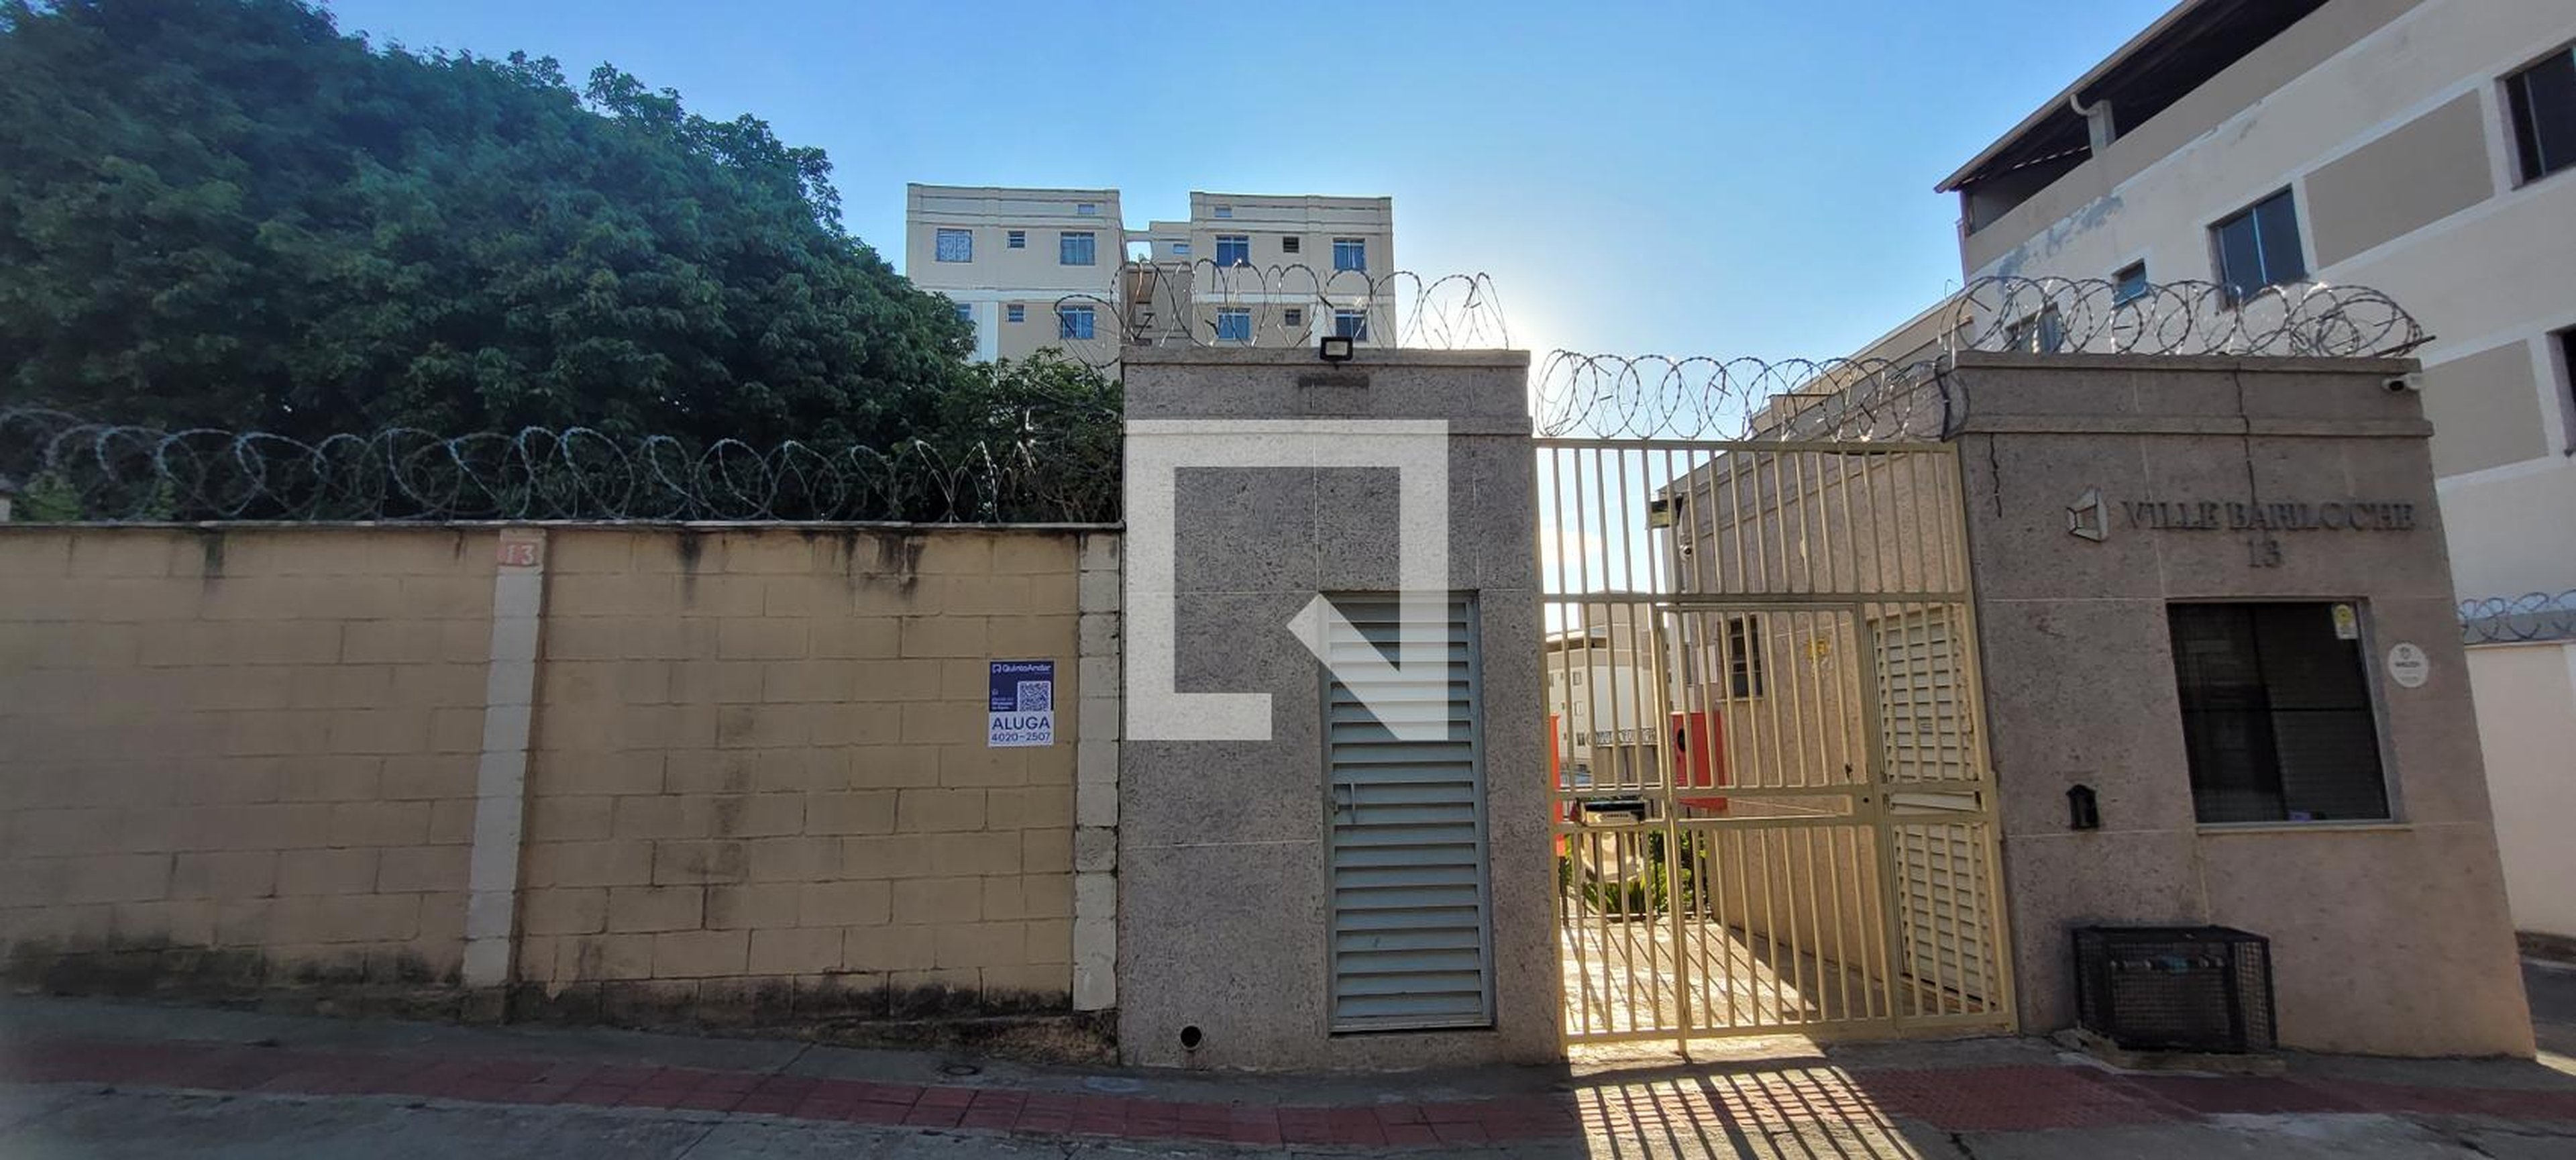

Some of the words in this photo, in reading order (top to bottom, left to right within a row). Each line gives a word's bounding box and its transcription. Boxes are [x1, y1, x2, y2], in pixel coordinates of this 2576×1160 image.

[2121, 500, 2220, 530] VILLE
[2224, 502, 2416, 531] BARILOCHE
[506, 544, 534, 565] 13
[991, 716, 1051, 730] ALUGA
[991, 732, 1051, 742] 4020-2507
